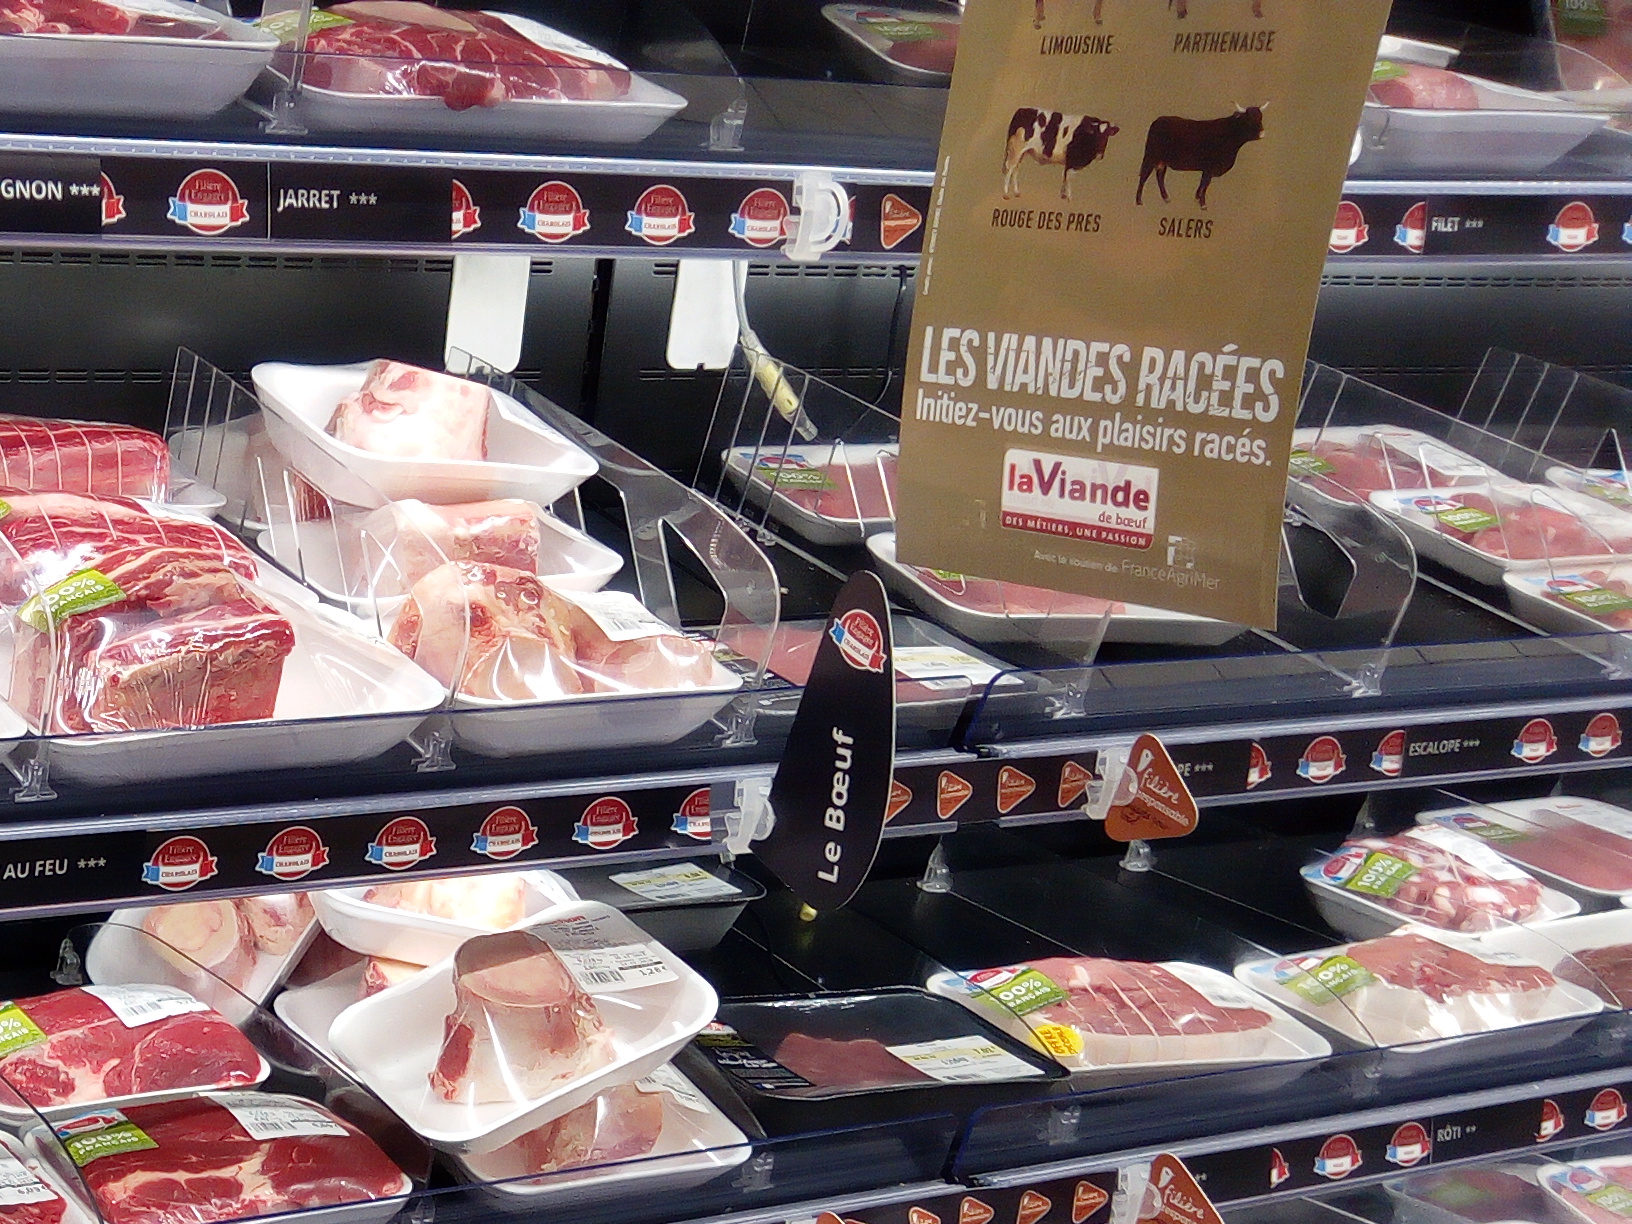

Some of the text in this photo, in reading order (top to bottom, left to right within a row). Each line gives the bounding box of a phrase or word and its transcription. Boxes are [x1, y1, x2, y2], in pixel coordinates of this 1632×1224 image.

[1040, 34, 1115, 56] LIMOUSINE
[1172, 31, 1275, 53] PARTHENAISE
[277, 189, 340, 212] JARRET
[991, 208, 1101, 233] ROUGE DES PRES
[1157, 217, 1214, 239] SALERS
[1431, 217, 1462, 232] FILET
[919, 325, 1285, 423] LES VIANDES RACÉES
[915, 389, 1271, 467] Initiez-vous aux plaisirs racés.
[1008, 458, 1150, 511] laViande
[1098, 511, 1112, 523] de
[1005, 516, 1147, 546] DES MÉTIERS, UNE PASSION
[1409, 739, 1460, 756] ESCALOPE
[817, 727, 856, 884] Le Bœuf
[3, 863, 30, 880] AU
[34, 859, 68, 878] FEU
[998, 979, 1042, 1000] 00%
[72, 1130, 133, 1150] 100%
[1437, 1124, 1462, 1142] RÔTI
